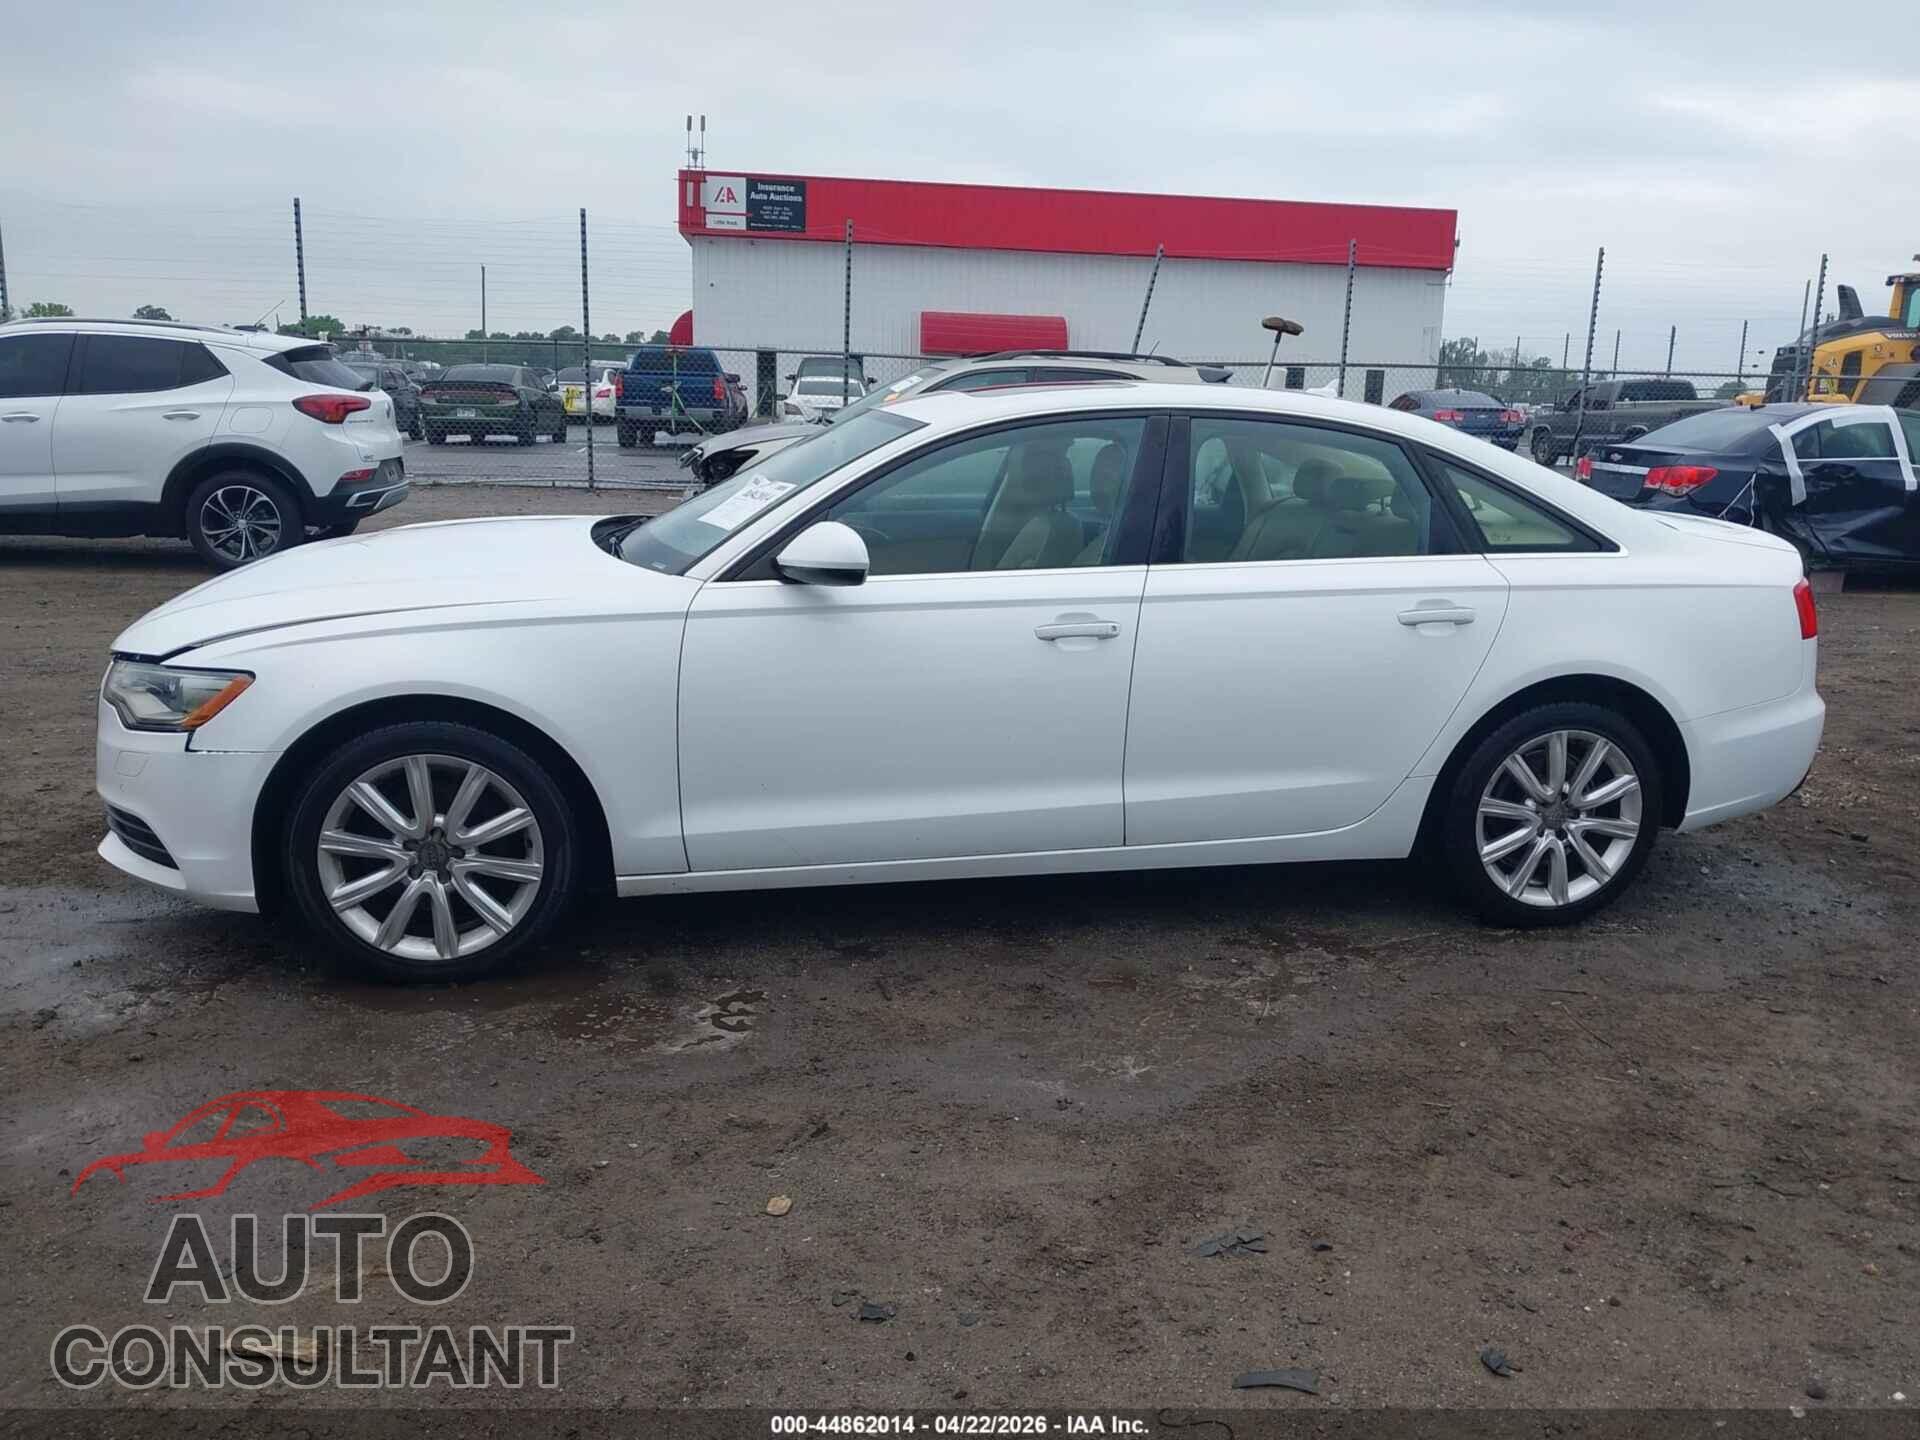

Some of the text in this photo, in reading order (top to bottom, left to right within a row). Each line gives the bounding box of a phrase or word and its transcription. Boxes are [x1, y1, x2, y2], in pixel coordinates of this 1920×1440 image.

[757, 182, 795, 193] Insurance
[750, 191, 803, 202] Auto Auctions
